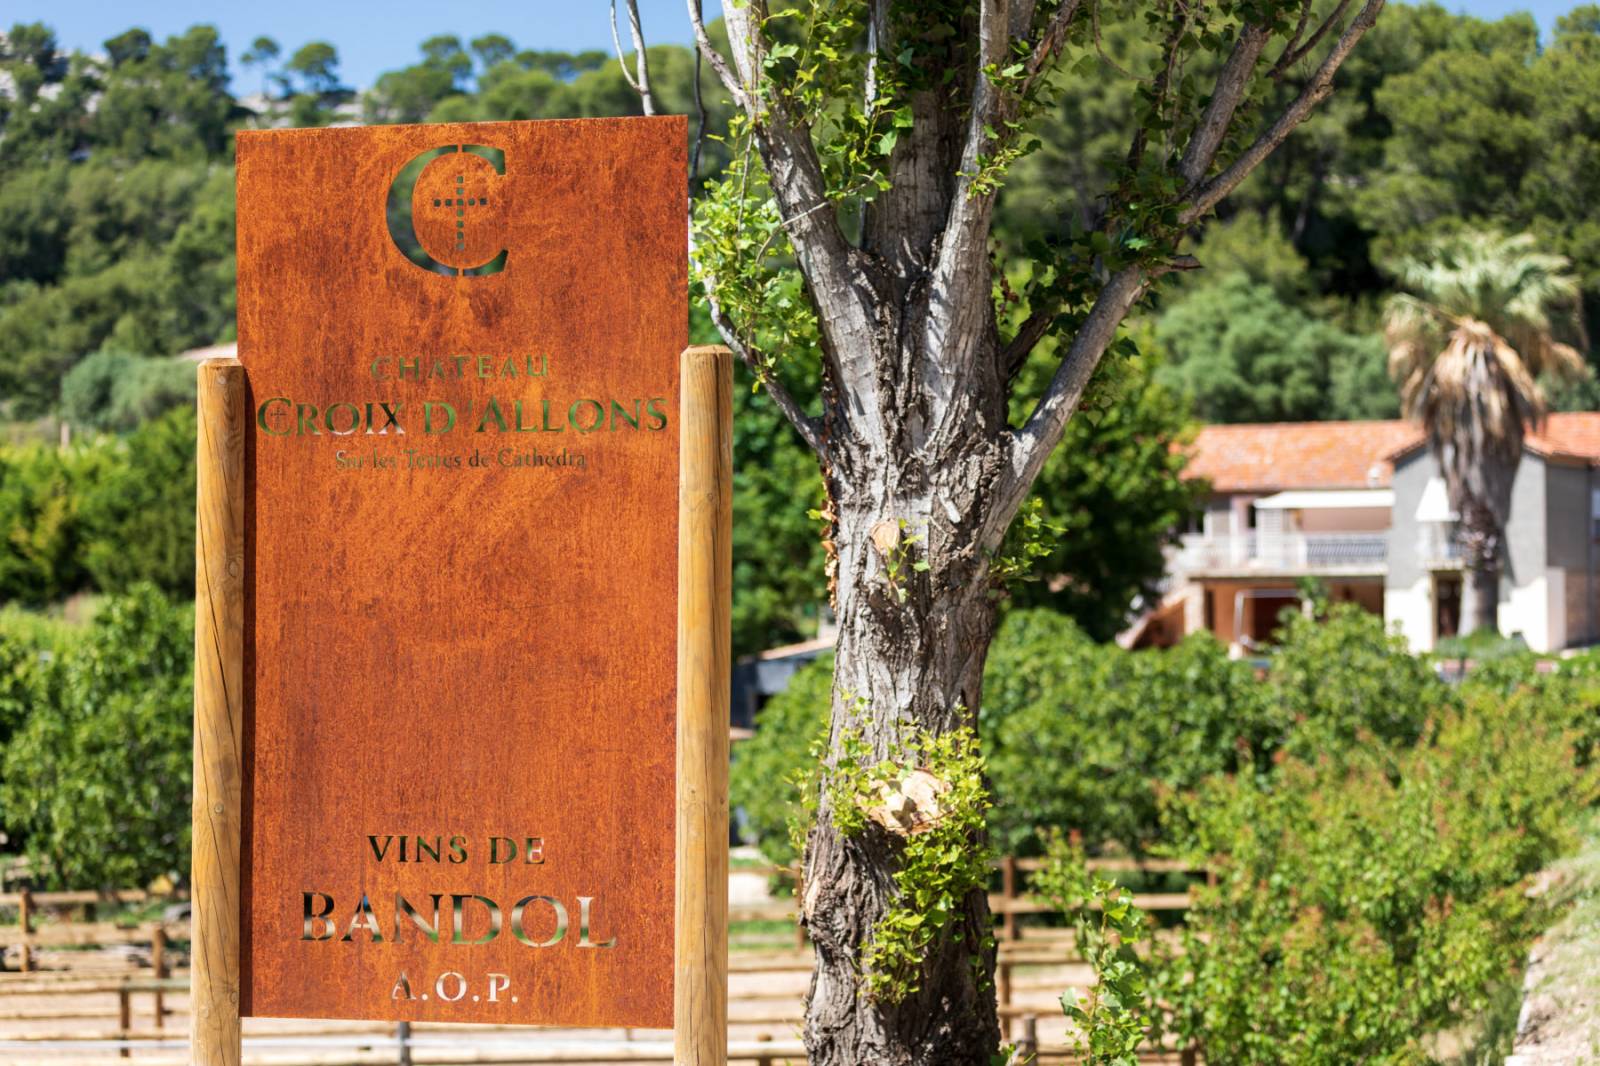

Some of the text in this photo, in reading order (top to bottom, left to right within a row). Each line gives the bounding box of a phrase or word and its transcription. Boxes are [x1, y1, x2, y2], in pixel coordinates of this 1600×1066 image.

[370, 352, 548, 381] CHATEAU
[257, 397, 406, 436] CROIX
[373, 448, 397, 469] les
[468, 448, 490, 467] de
[368, 835, 546, 865] VINS DE
[300, 891, 618, 949] BANDOL
[391, 970, 520, 1003] A.O.P.
